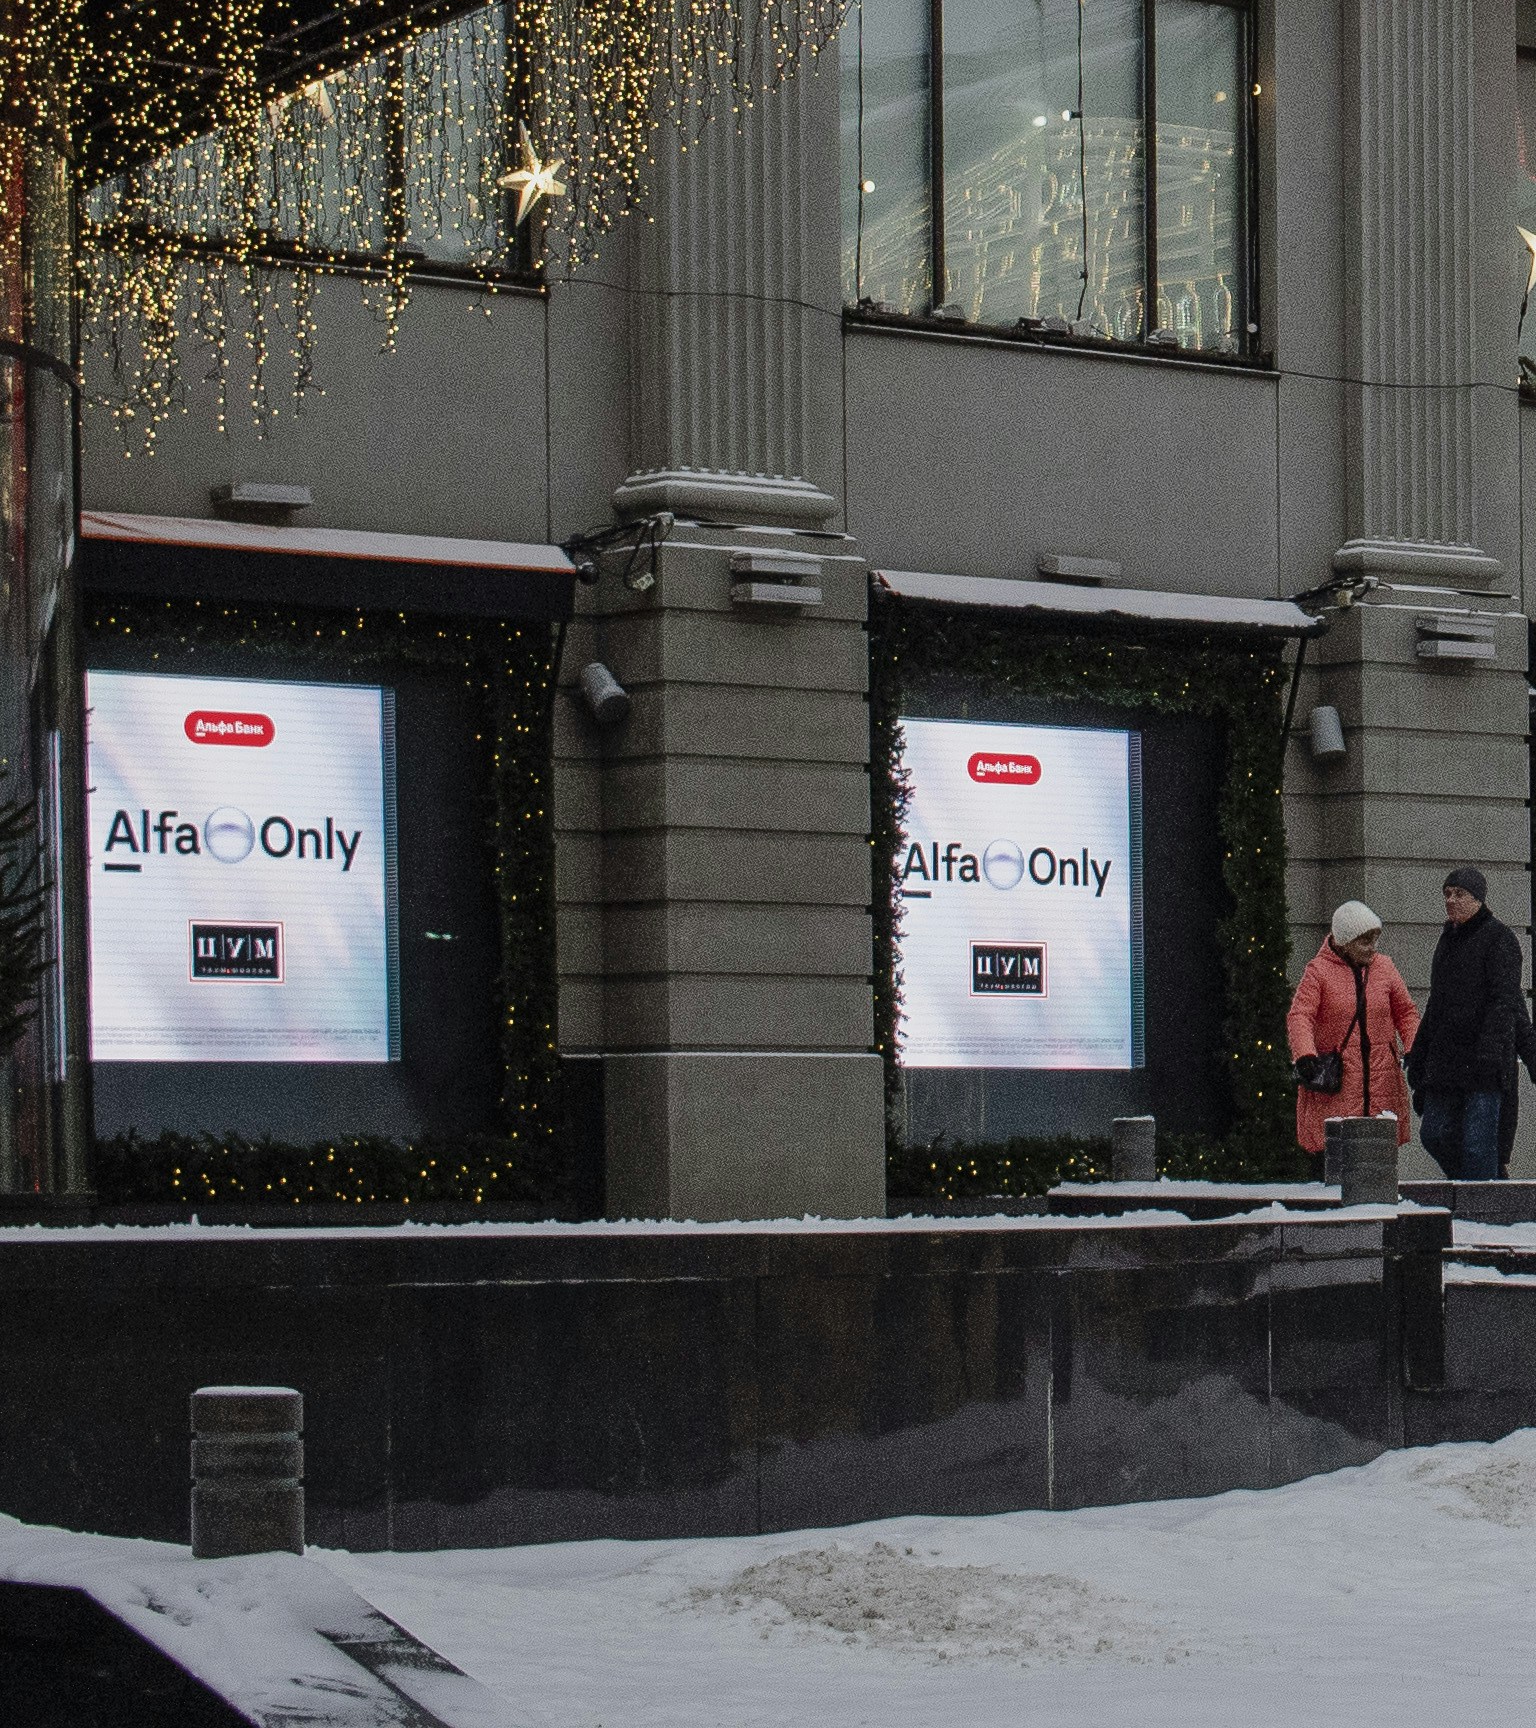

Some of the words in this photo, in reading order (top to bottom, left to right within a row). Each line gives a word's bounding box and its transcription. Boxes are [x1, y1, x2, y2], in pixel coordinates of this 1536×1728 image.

[104, 808, 201, 872] Alfa
[260, 815, 362, 873] Only
[903, 841, 981, 898] Alfa
[1028, 846, 1112, 898] Only
